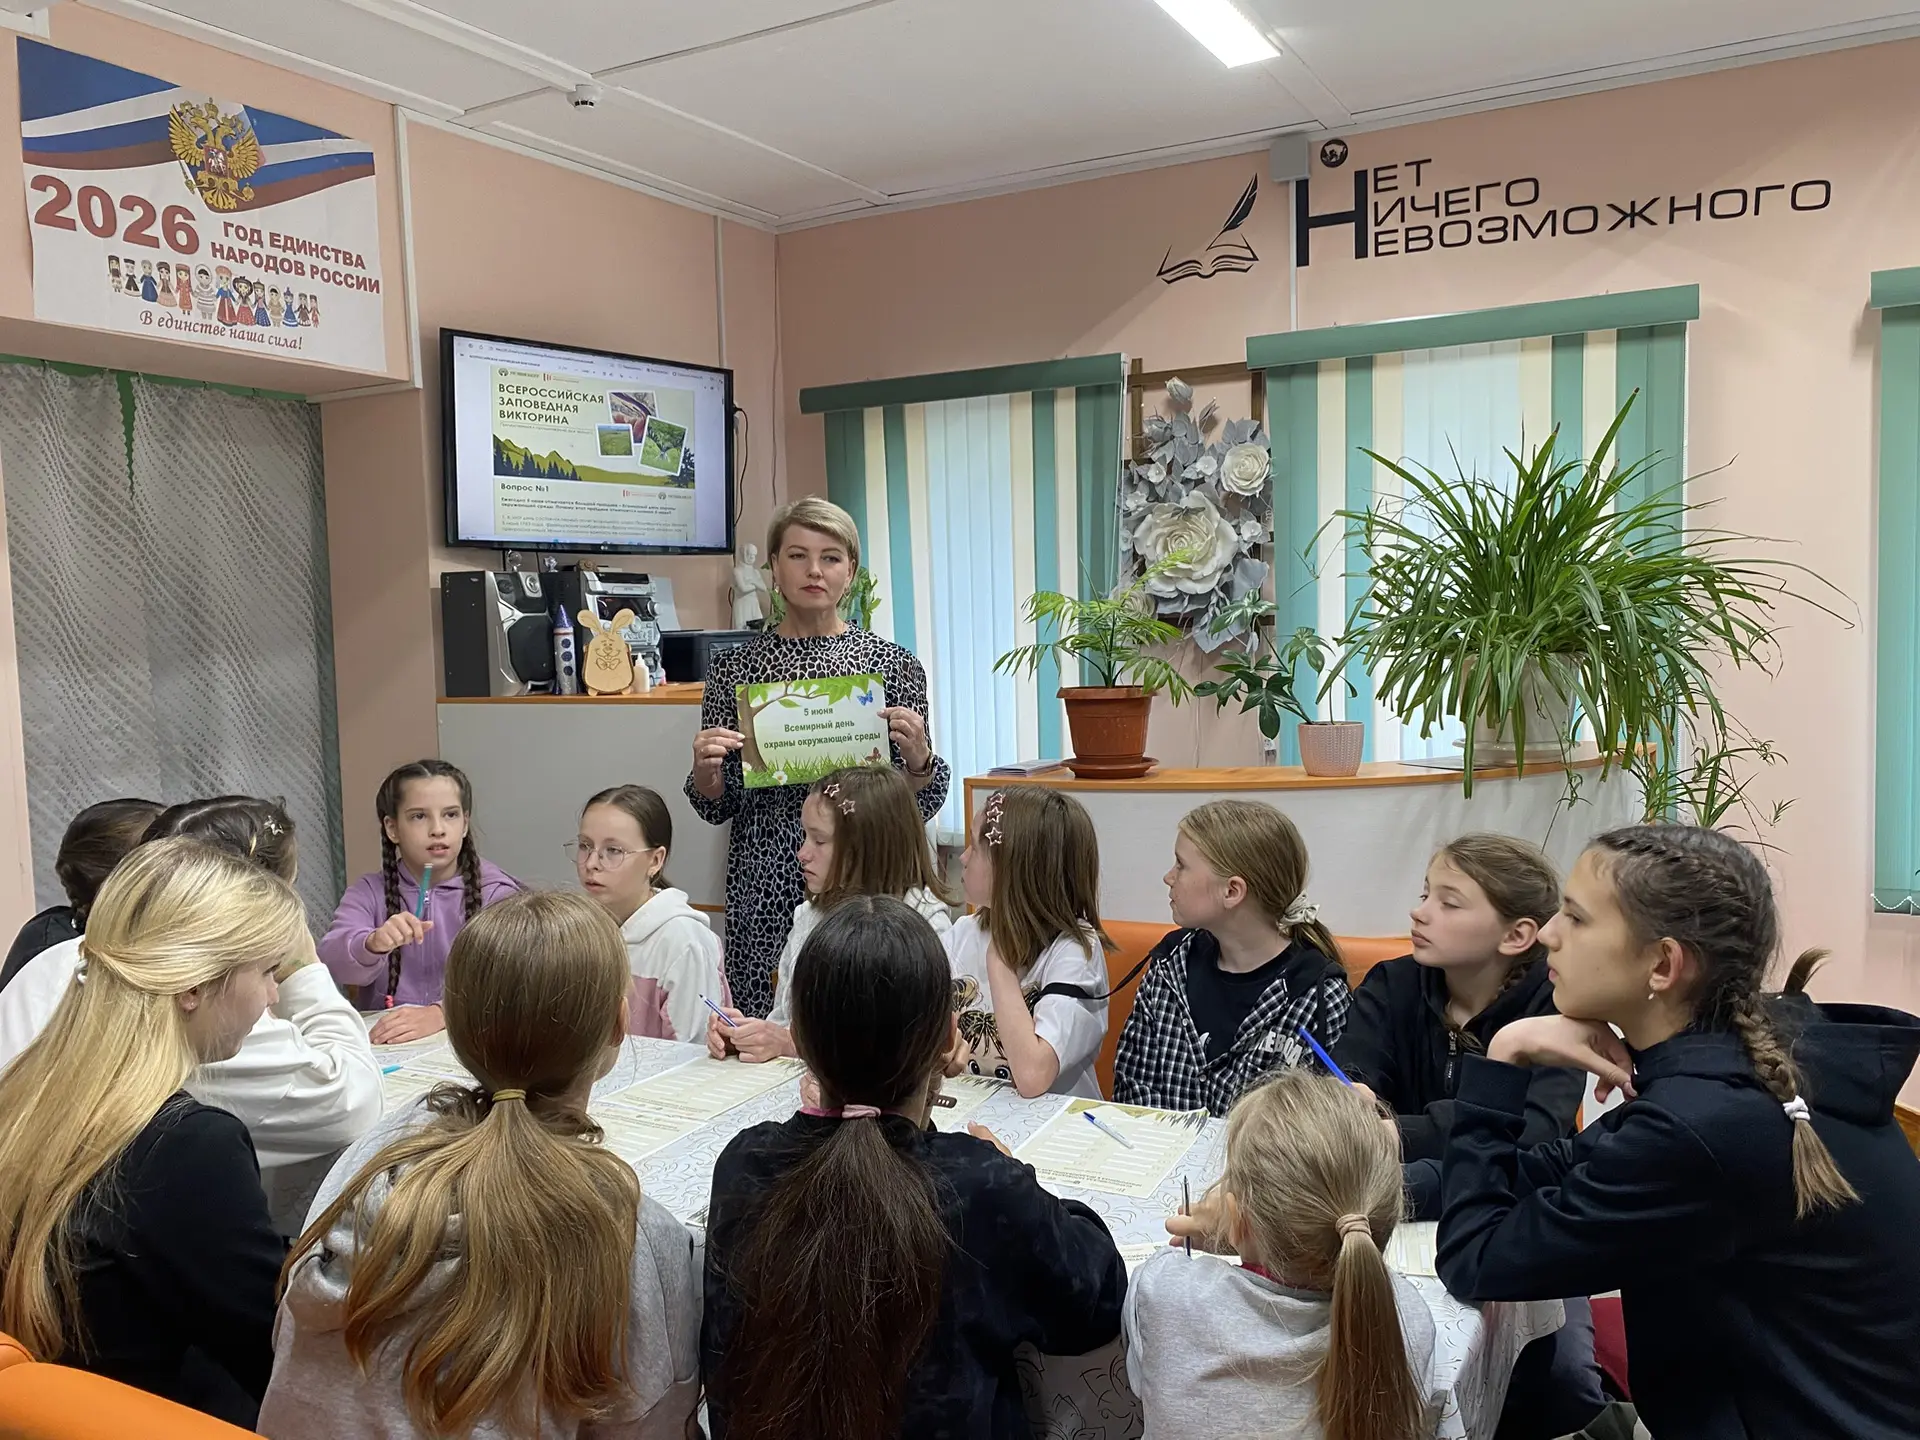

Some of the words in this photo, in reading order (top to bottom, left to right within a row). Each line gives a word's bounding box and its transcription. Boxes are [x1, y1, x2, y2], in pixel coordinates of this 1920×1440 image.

[29, 174, 200, 256] 2026
[223, 220, 264, 248] ГОД
[269, 230, 366, 270] ЕДИНСТВА
[211, 242, 306, 277] НАРОДОВ
[310, 265, 381, 295] РОССИИ
[139, 310, 153, 326] В
[157, 314, 226, 337] единстве
[228, 325, 266, 345] наша
[268, 334, 303, 350] сила!
[498, 383, 604, 404] ВСЕРОССИЙСКАЯ
[498, 397, 579, 414] ЗАПОВЕДНАЯ
[499, 410, 569, 425] ВИКТОРИНА
[500, 482, 534, 492] Вопрос
[535, 484, 550, 493] №1
[804, 708, 809, 716] 5
[811, 707, 834, 716] июня
[784, 720, 834, 733] Всемирный
[835, 720, 855, 729] день
[764, 737, 796, 750] охраны
[797, 733, 853, 747] окружающей
[854, 732, 881, 743] среды
